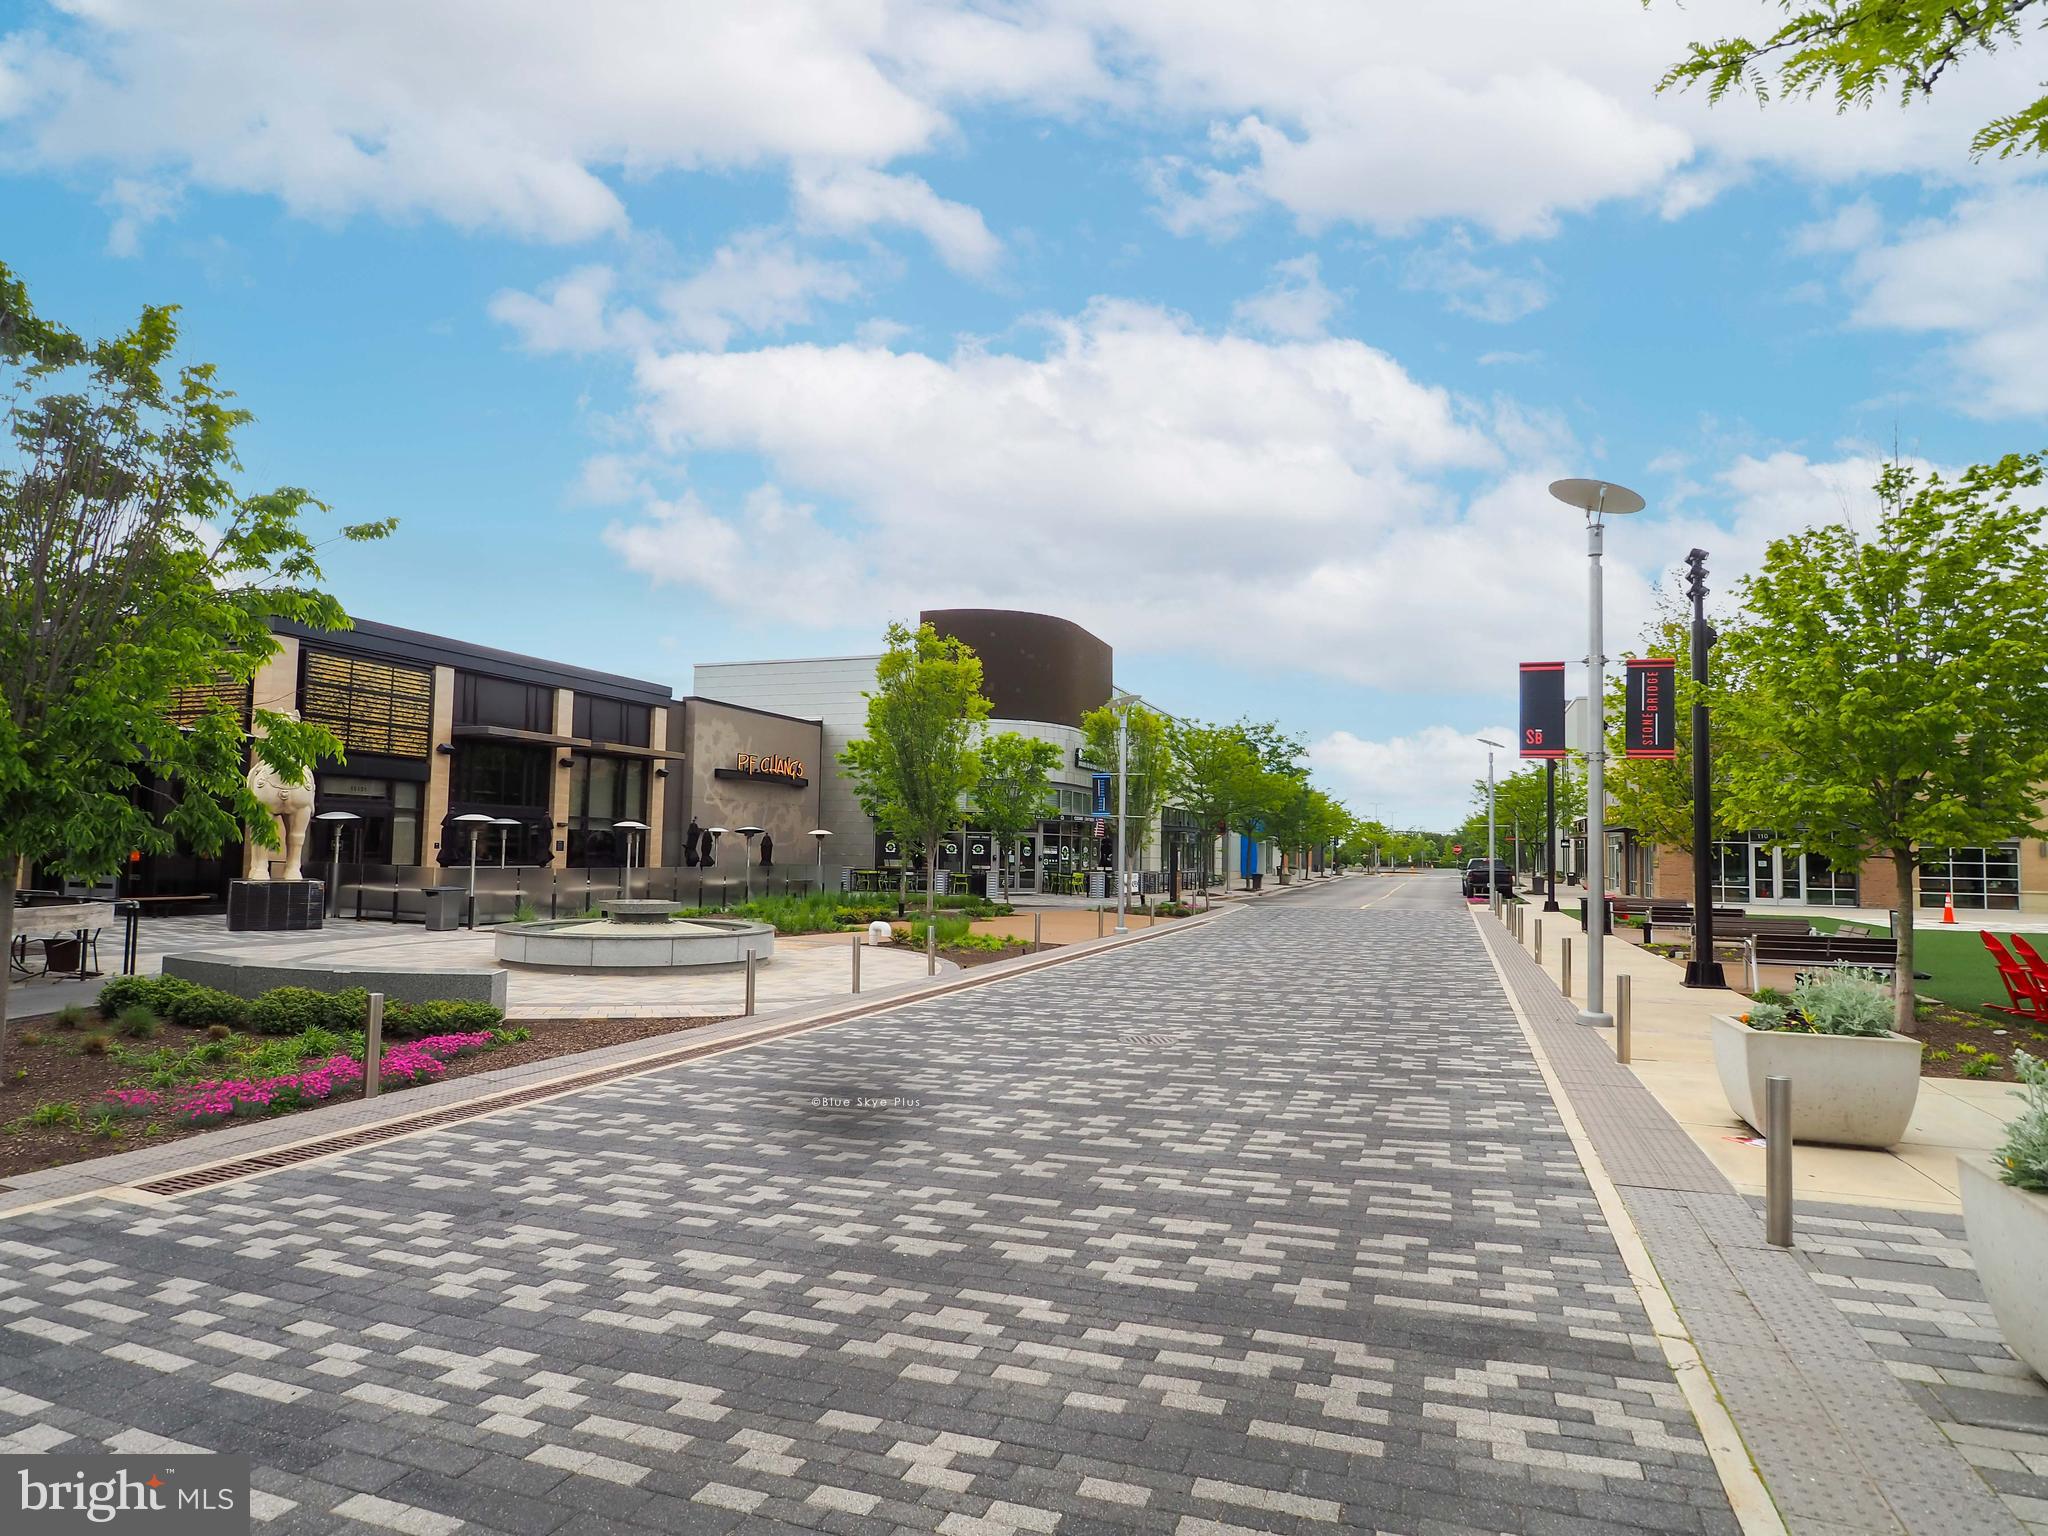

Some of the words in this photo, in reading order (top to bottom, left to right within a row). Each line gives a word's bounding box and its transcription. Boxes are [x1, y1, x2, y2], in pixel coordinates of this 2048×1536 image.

[1647, 671, 1659, 711] BRIDGE
[1526, 728, 1543, 745] SB
[1642, 713, 1654, 745] STONE
